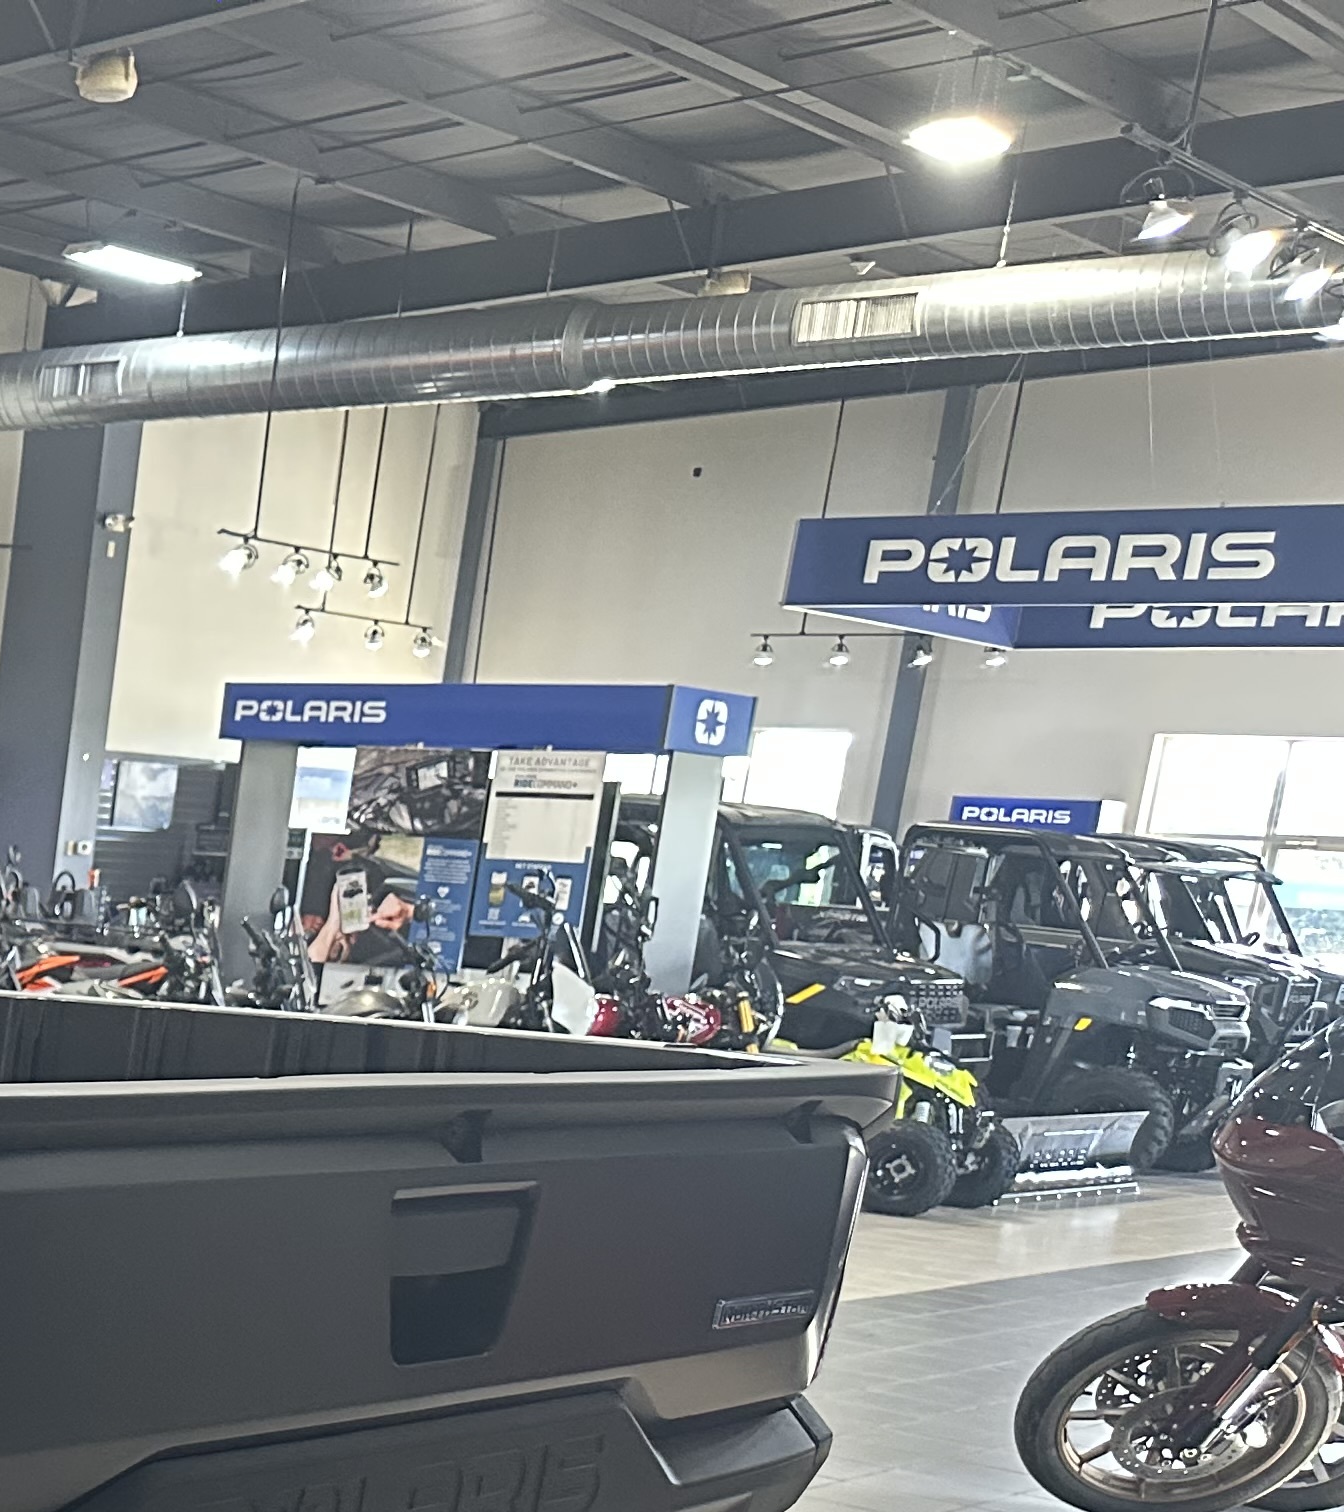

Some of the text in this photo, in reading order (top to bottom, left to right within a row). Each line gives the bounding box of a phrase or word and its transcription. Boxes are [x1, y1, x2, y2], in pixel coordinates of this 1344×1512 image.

[863, 531, 1276, 584] POLARIS
[234, 700, 387, 723] POLARIS
[961, 806, 1071, 824] POLARIS
